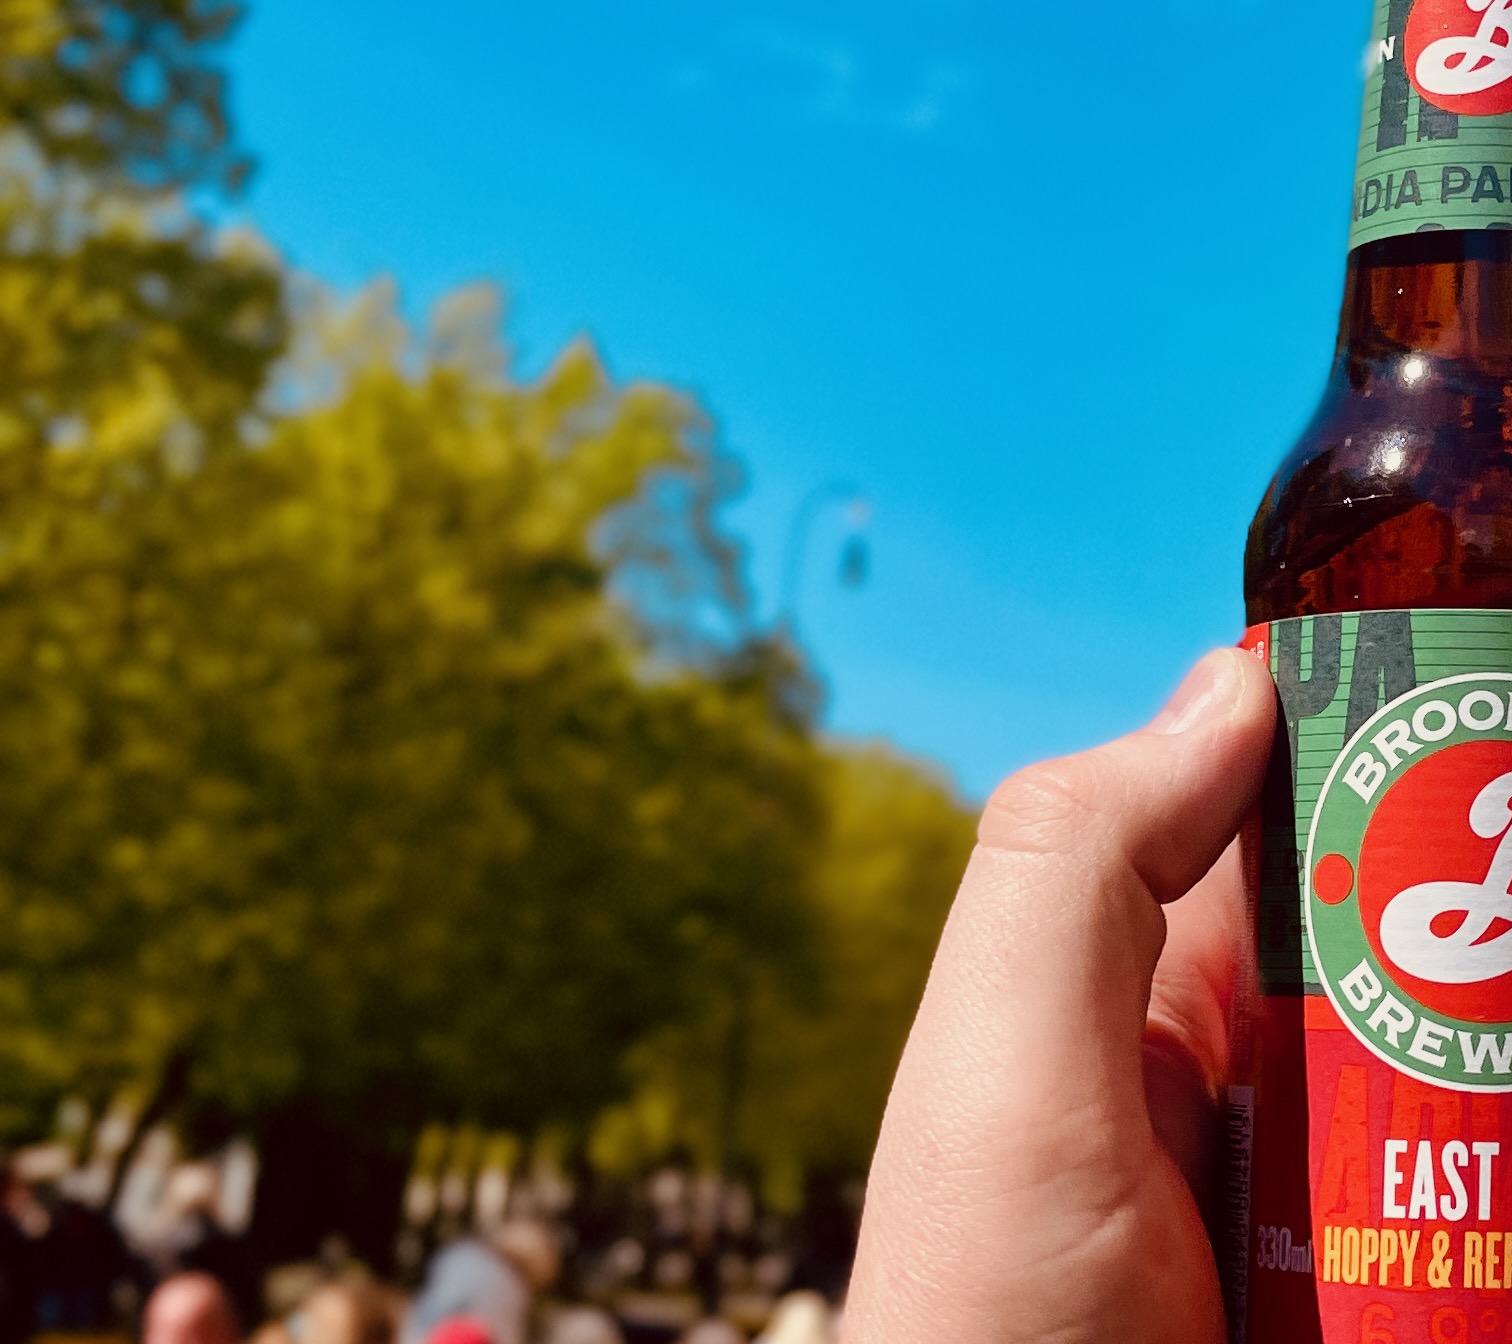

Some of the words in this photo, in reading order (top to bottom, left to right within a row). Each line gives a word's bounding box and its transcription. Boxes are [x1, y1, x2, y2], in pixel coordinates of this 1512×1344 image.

[1382, 1138, 1500, 1222] EAST
[1323, 1226, 1422, 1288] HOPPY
[1427, 1229, 1453, 1290] &
